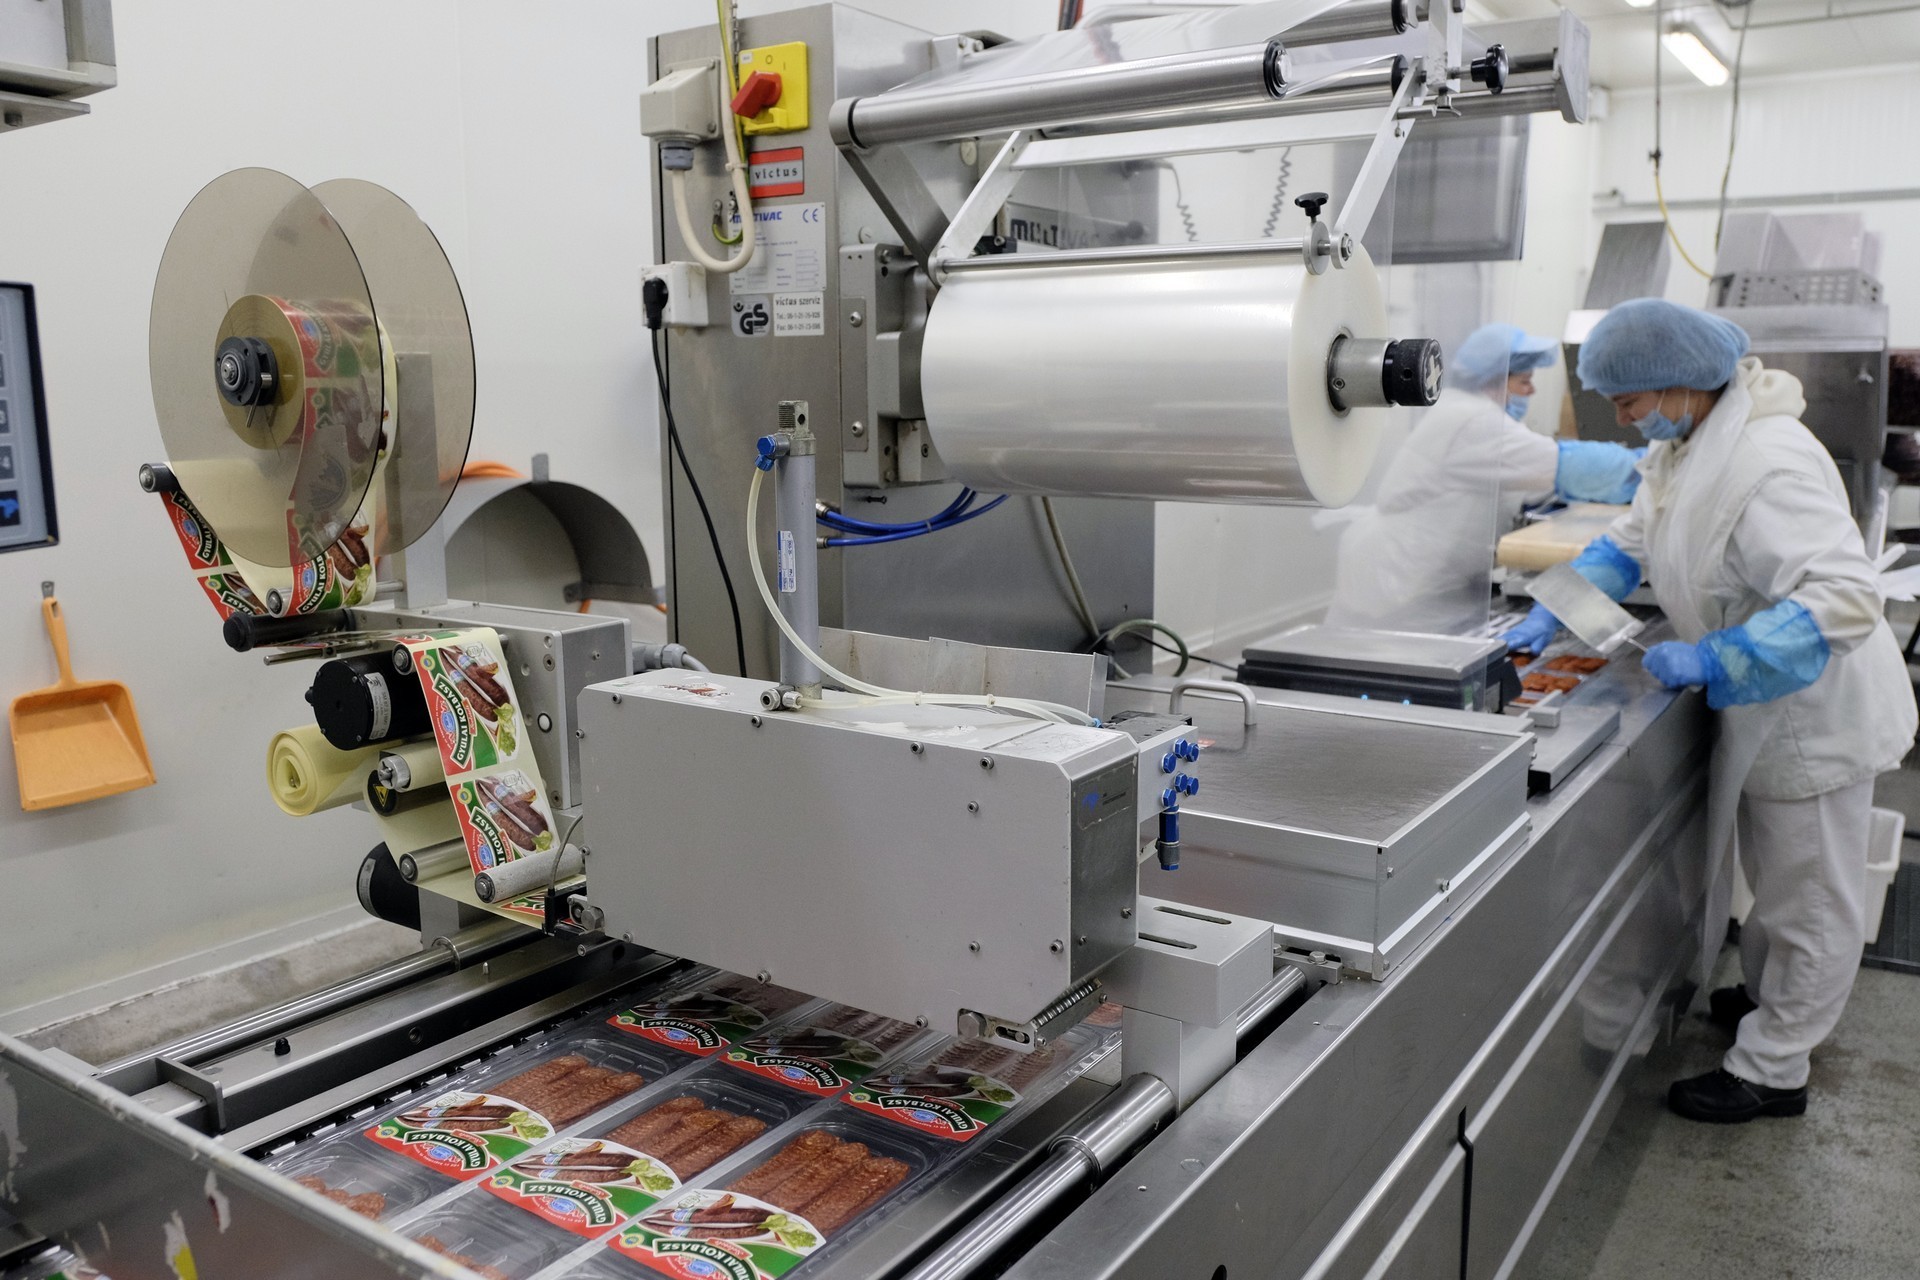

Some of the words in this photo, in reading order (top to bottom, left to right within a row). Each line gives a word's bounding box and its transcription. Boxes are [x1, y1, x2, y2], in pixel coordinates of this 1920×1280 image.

[755, 168, 798, 179] victus
[302, 582, 325, 611] GYULAI
[457, 723, 468, 760] GYULAI
[941, 1106, 968, 1130] GYULAI
[585, 1195, 606, 1223] GYULAI
[661, 1242, 727, 1261] KOLBÁSZ
